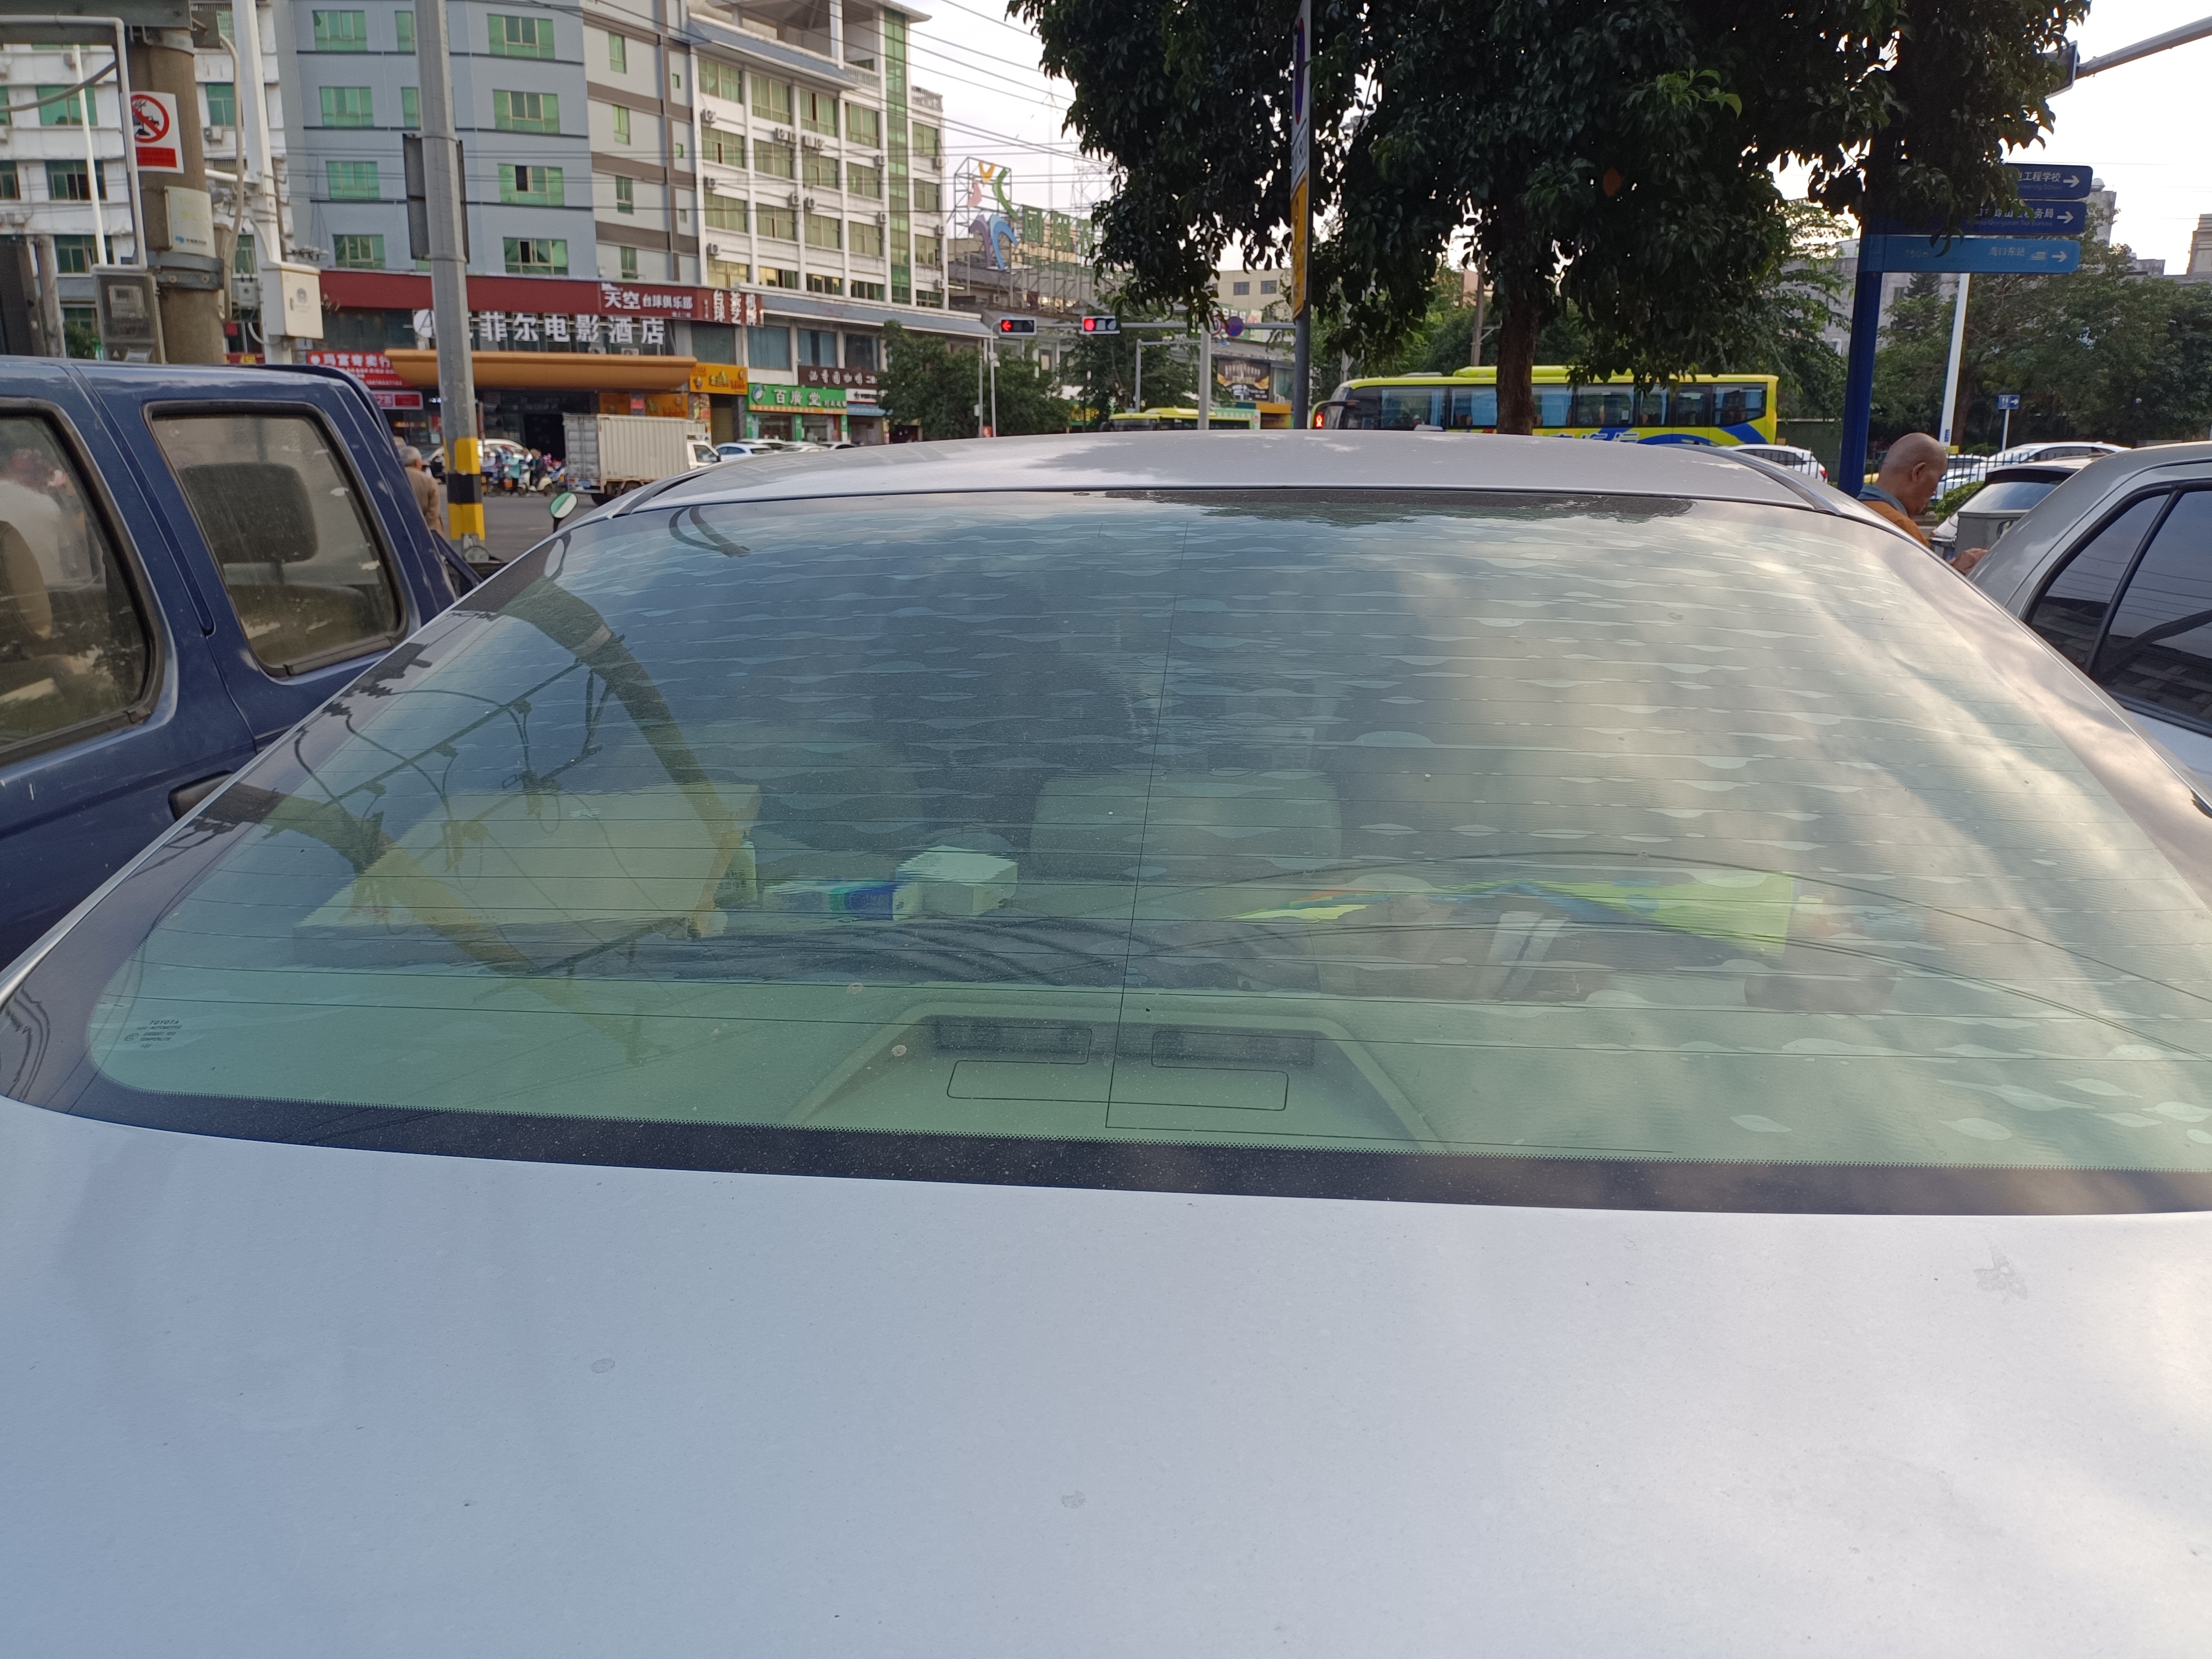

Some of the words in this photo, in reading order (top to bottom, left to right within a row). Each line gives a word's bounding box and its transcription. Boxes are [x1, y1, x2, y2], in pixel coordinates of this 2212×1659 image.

[1989, 246, 2026, 257] 海口东站
[468, 310, 664, 345] 菲尔电影酒店
[773, 389, 821, 406] 百廣堂
